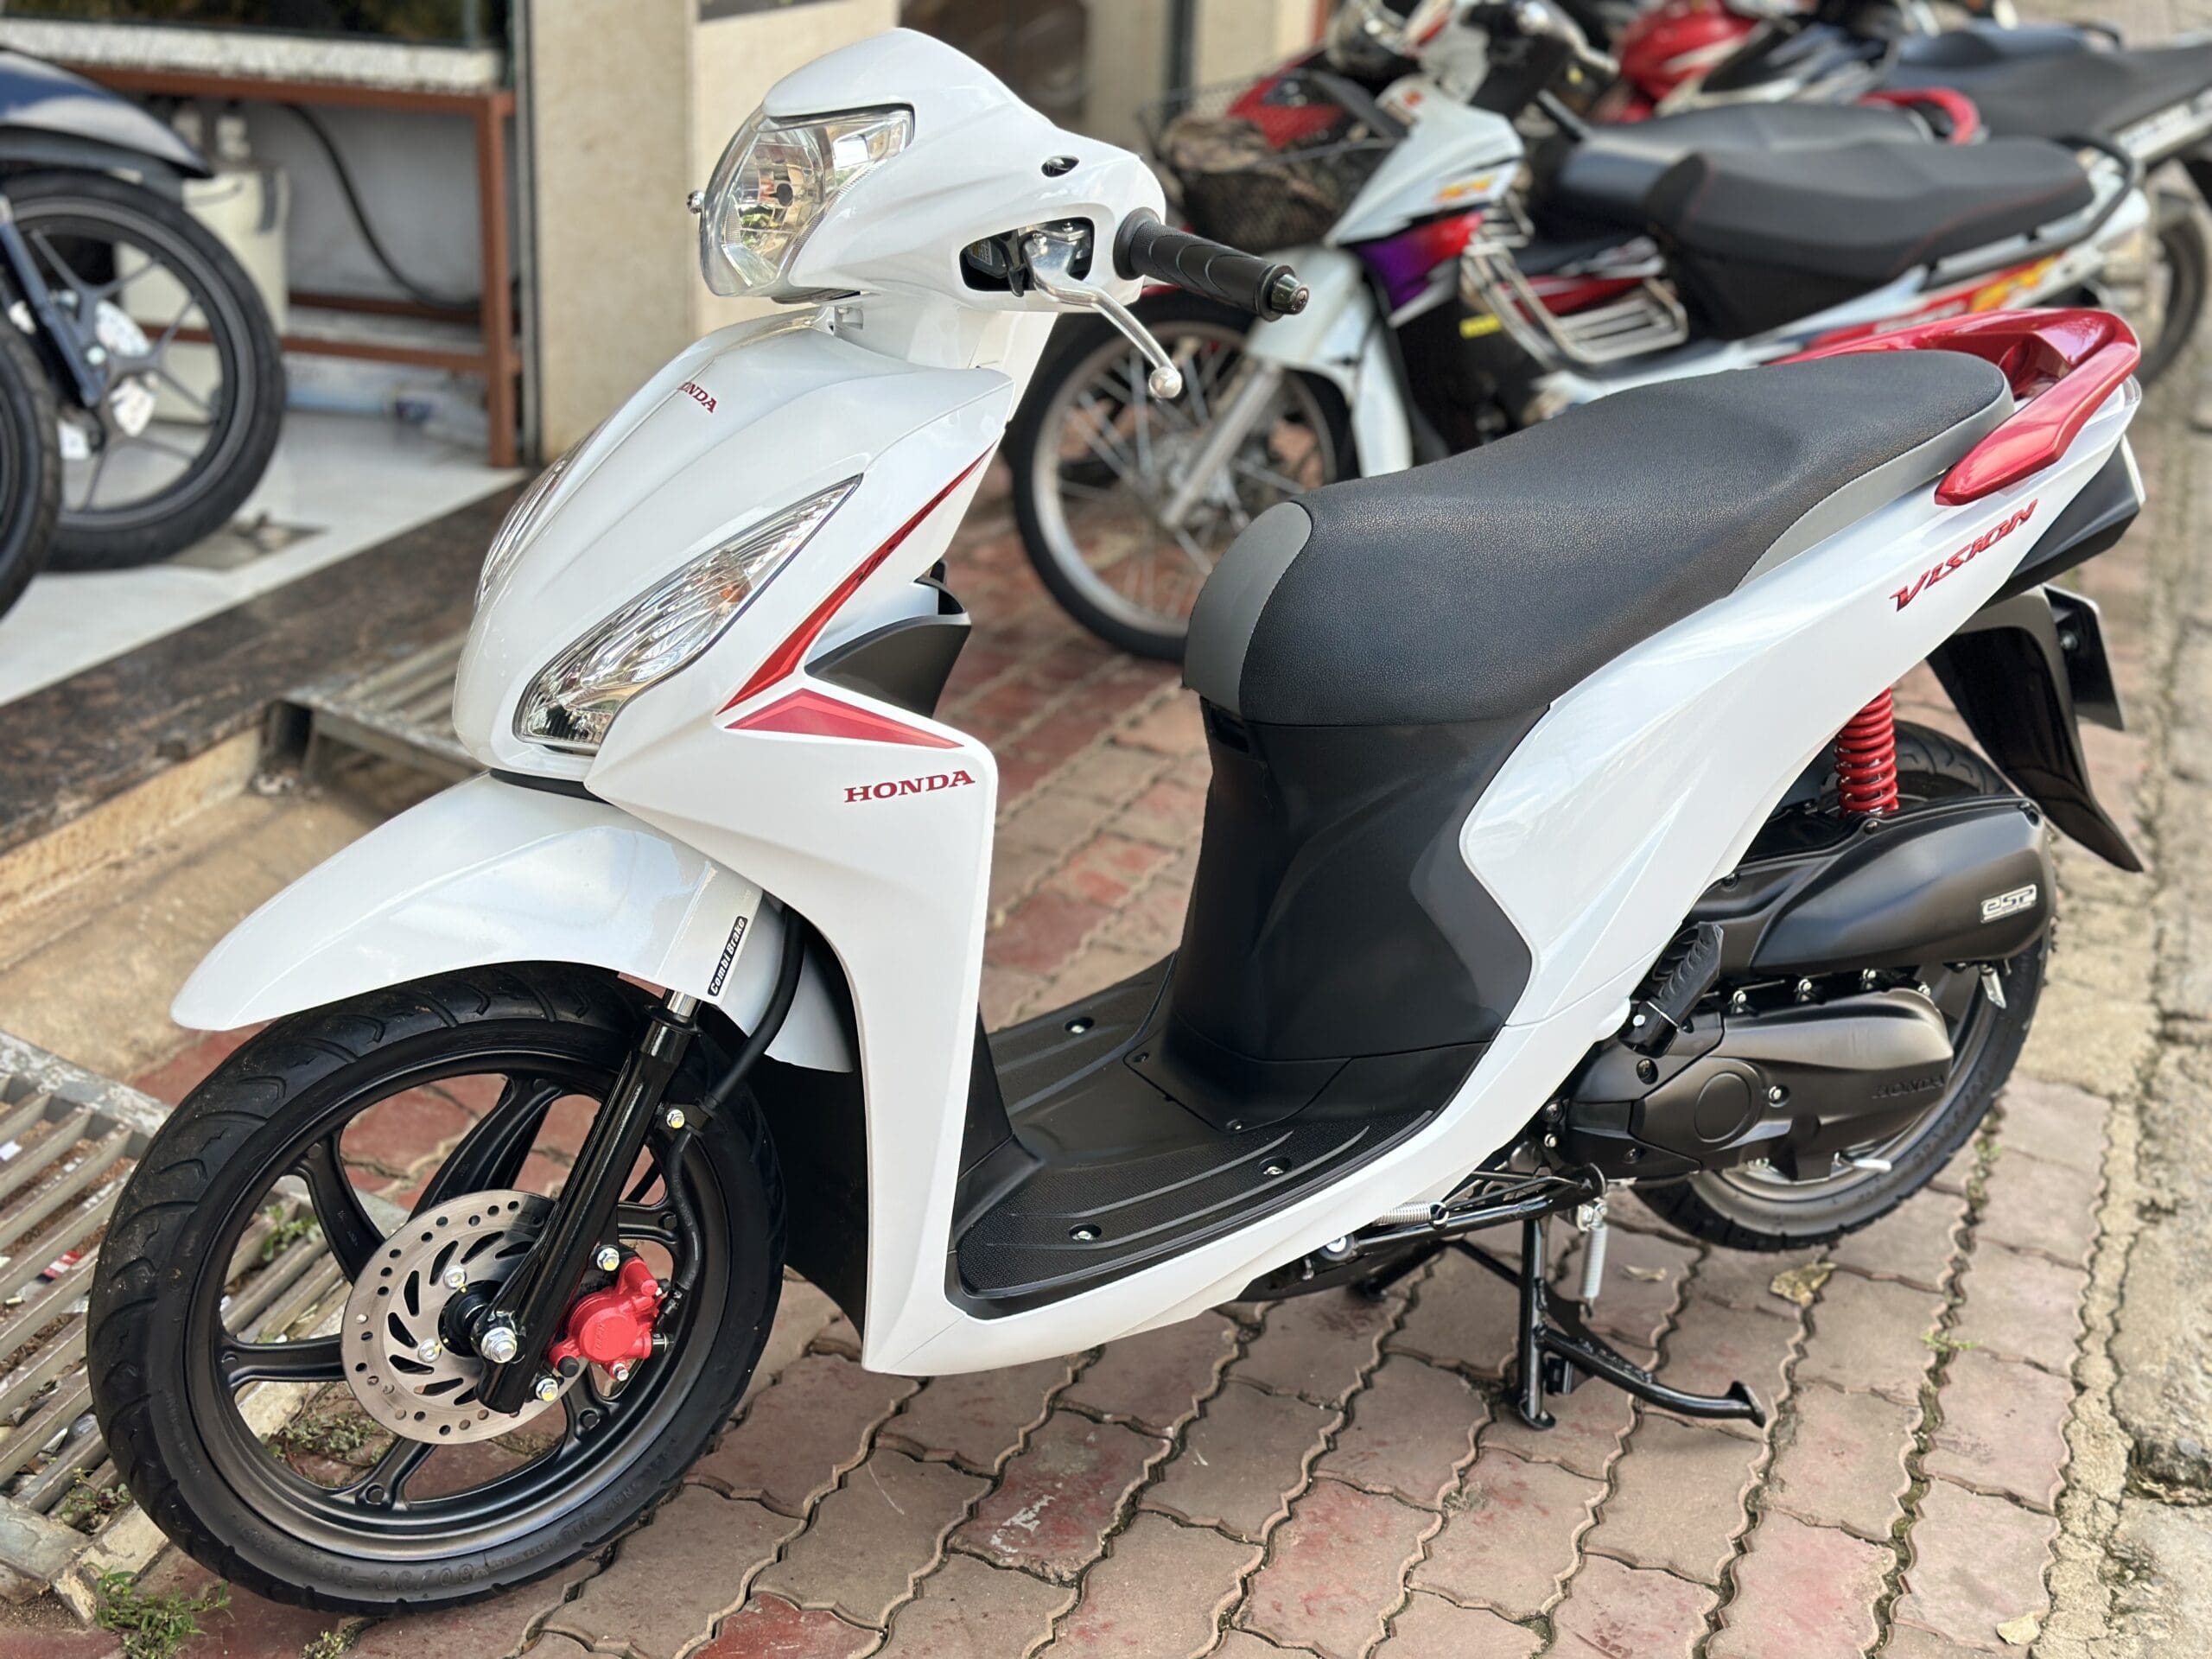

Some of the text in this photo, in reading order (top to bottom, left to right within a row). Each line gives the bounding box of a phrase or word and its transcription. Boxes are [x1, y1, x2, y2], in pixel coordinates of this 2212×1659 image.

[677, 381, 717, 414] ONDA
[1889, 499, 2038, 612] VISION
[844, 770, 976, 803] HONDA
[710, 918, 745, 995] Combi Brake
